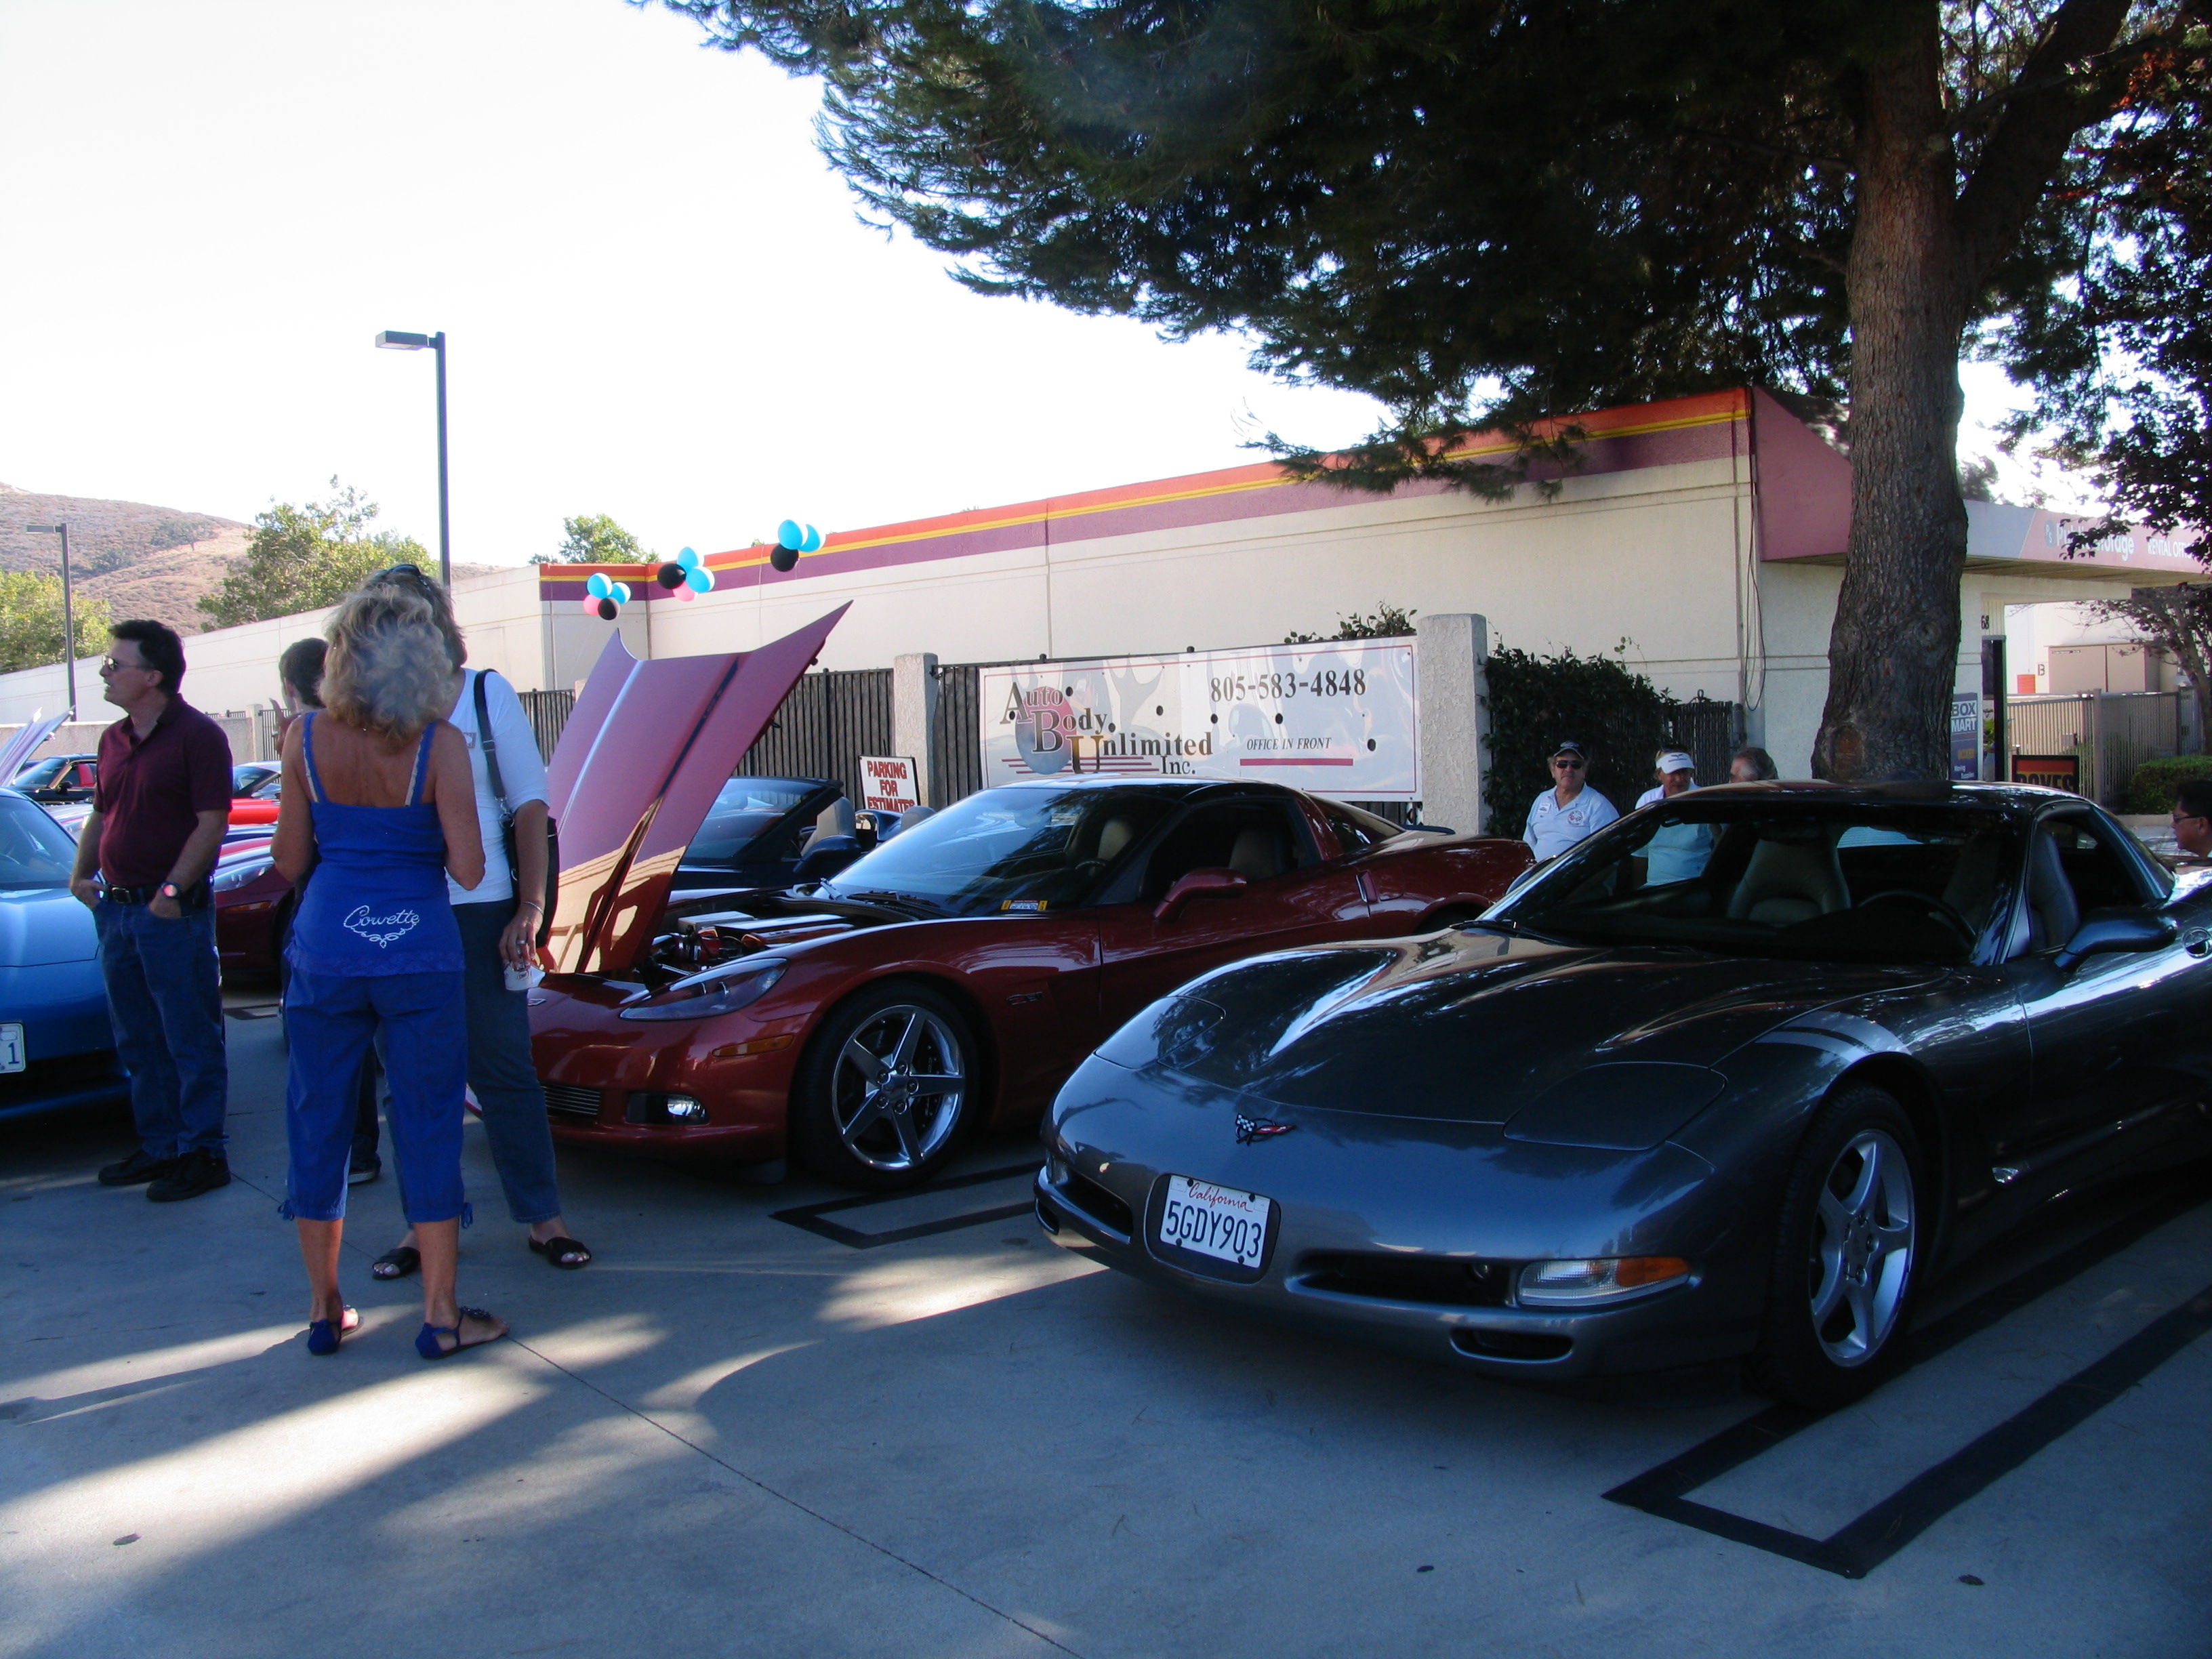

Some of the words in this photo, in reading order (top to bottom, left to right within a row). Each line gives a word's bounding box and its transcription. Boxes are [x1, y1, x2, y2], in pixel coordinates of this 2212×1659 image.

[2172, 541, 2193, 559] OFFIC
[1210, 668, 1366, 702] 805-583-4848
[1000, 682, 1064, 724] Auto
[1952, 701, 1977, 717] BOX
[1031, 708, 1108, 753] Body
[1951, 718, 1978, 733] MART
[1066, 731, 1214, 774] Unlimited
[1246, 738, 1279, 750] OFFICE
[1282, 737, 1294, 750] IN
[1297, 737, 1332, 750] FRONT
[867, 760, 907, 779] PARKING
[1161, 756, 1195, 775] Inc.
[880, 779, 899, 797] FOR
[1189, 1182, 1254, 1212] California
[1166, 1200, 1262, 1258] 5GDY903
